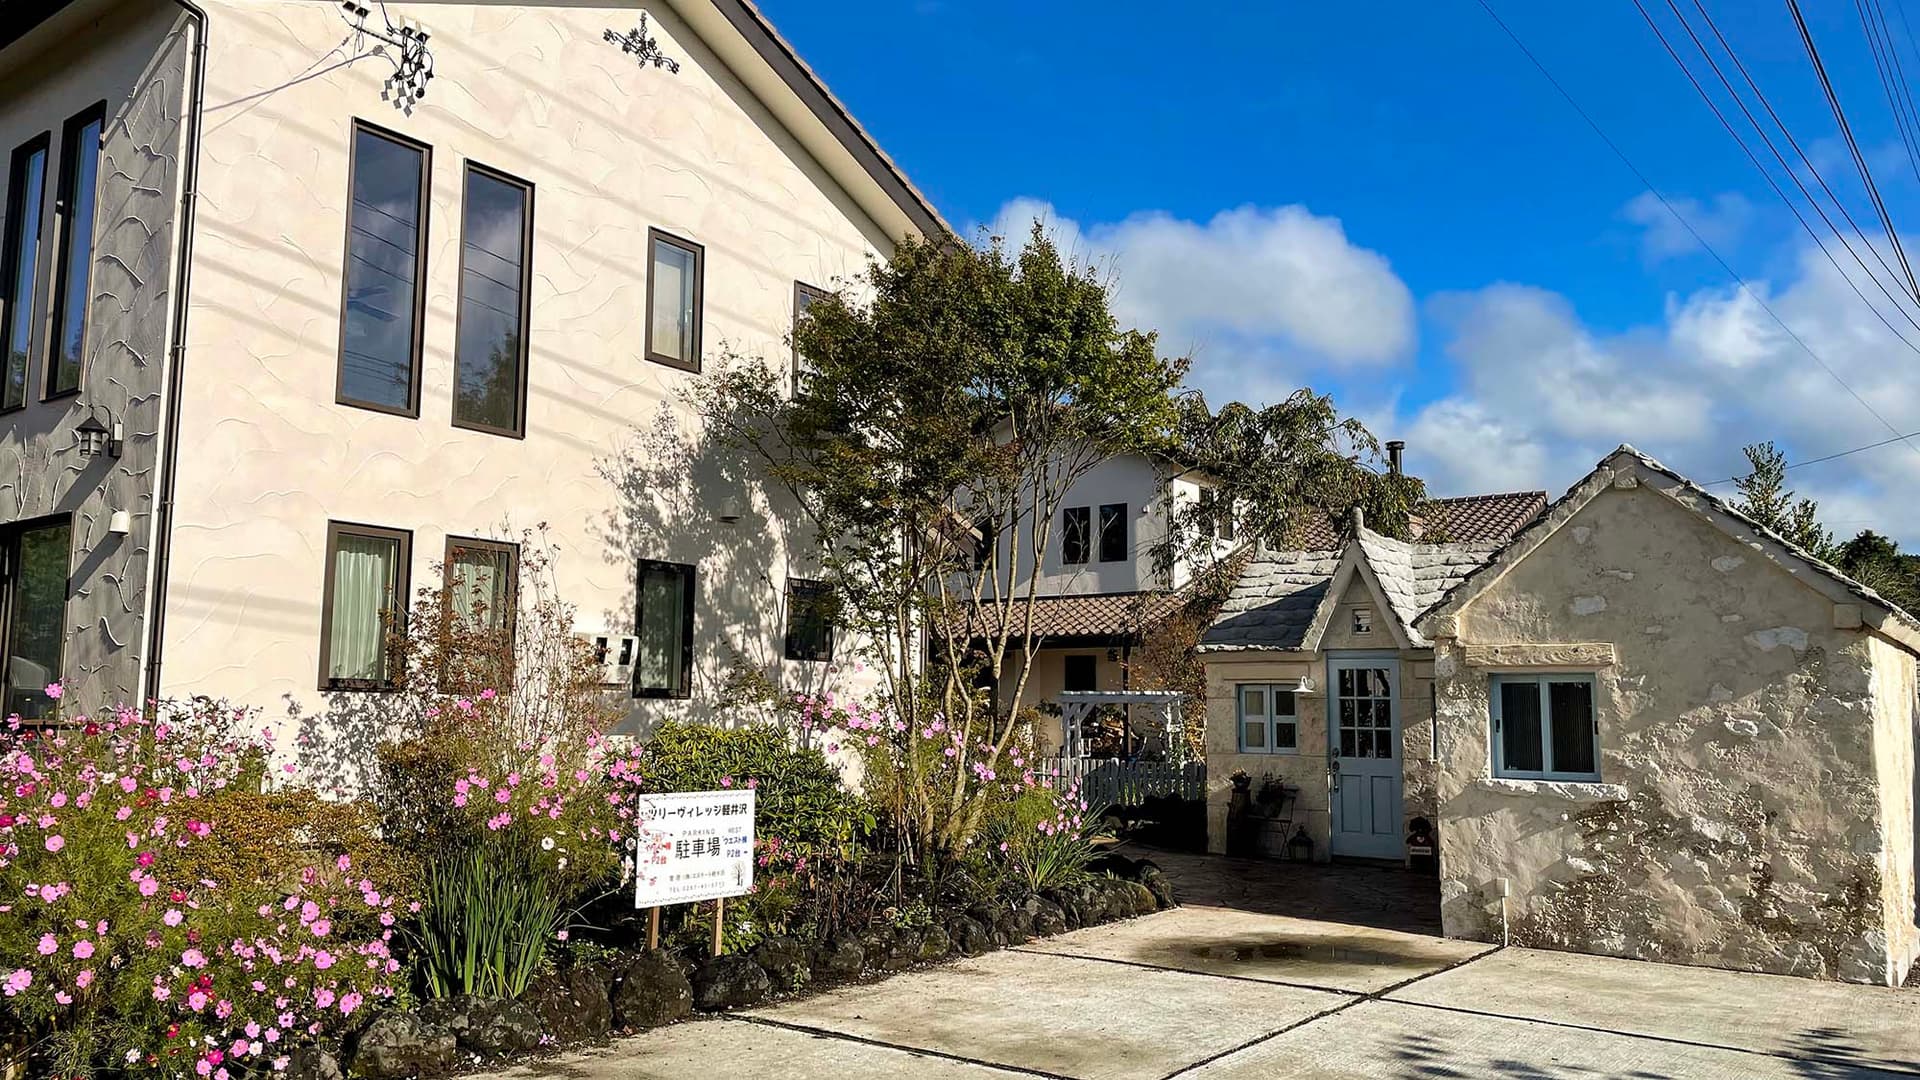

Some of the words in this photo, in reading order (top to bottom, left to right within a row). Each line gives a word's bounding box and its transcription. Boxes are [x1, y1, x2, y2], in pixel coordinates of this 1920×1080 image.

[648, 803, 748, 820] ツリーヴィレッジ軽井沢
[682, 828, 716, 836] PARKING
[728, 826, 742, 834] WEST
[675, 836, 721, 860] 駐車場
